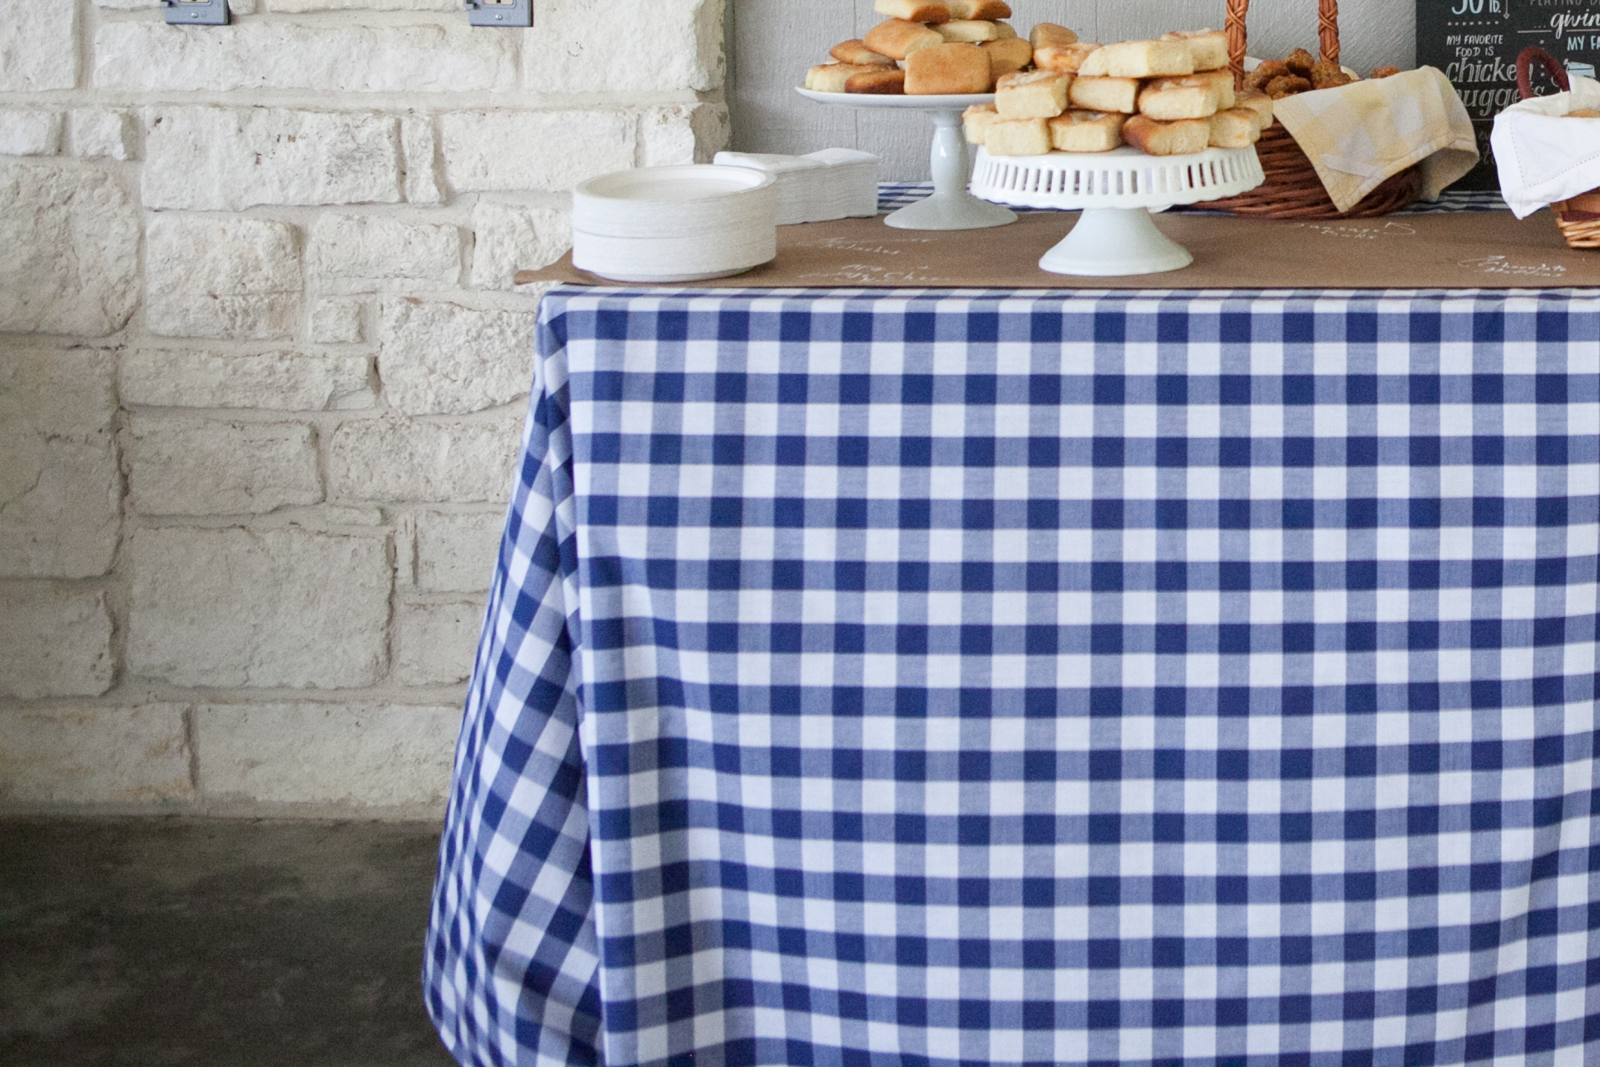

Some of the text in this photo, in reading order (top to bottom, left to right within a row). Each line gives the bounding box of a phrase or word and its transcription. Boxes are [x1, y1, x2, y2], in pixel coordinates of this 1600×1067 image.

[1464, 34, 1503, 45] FAVORITE
[1567, 36, 1585, 51] MY
[1456, 46, 1494, 57] FOOD IS
